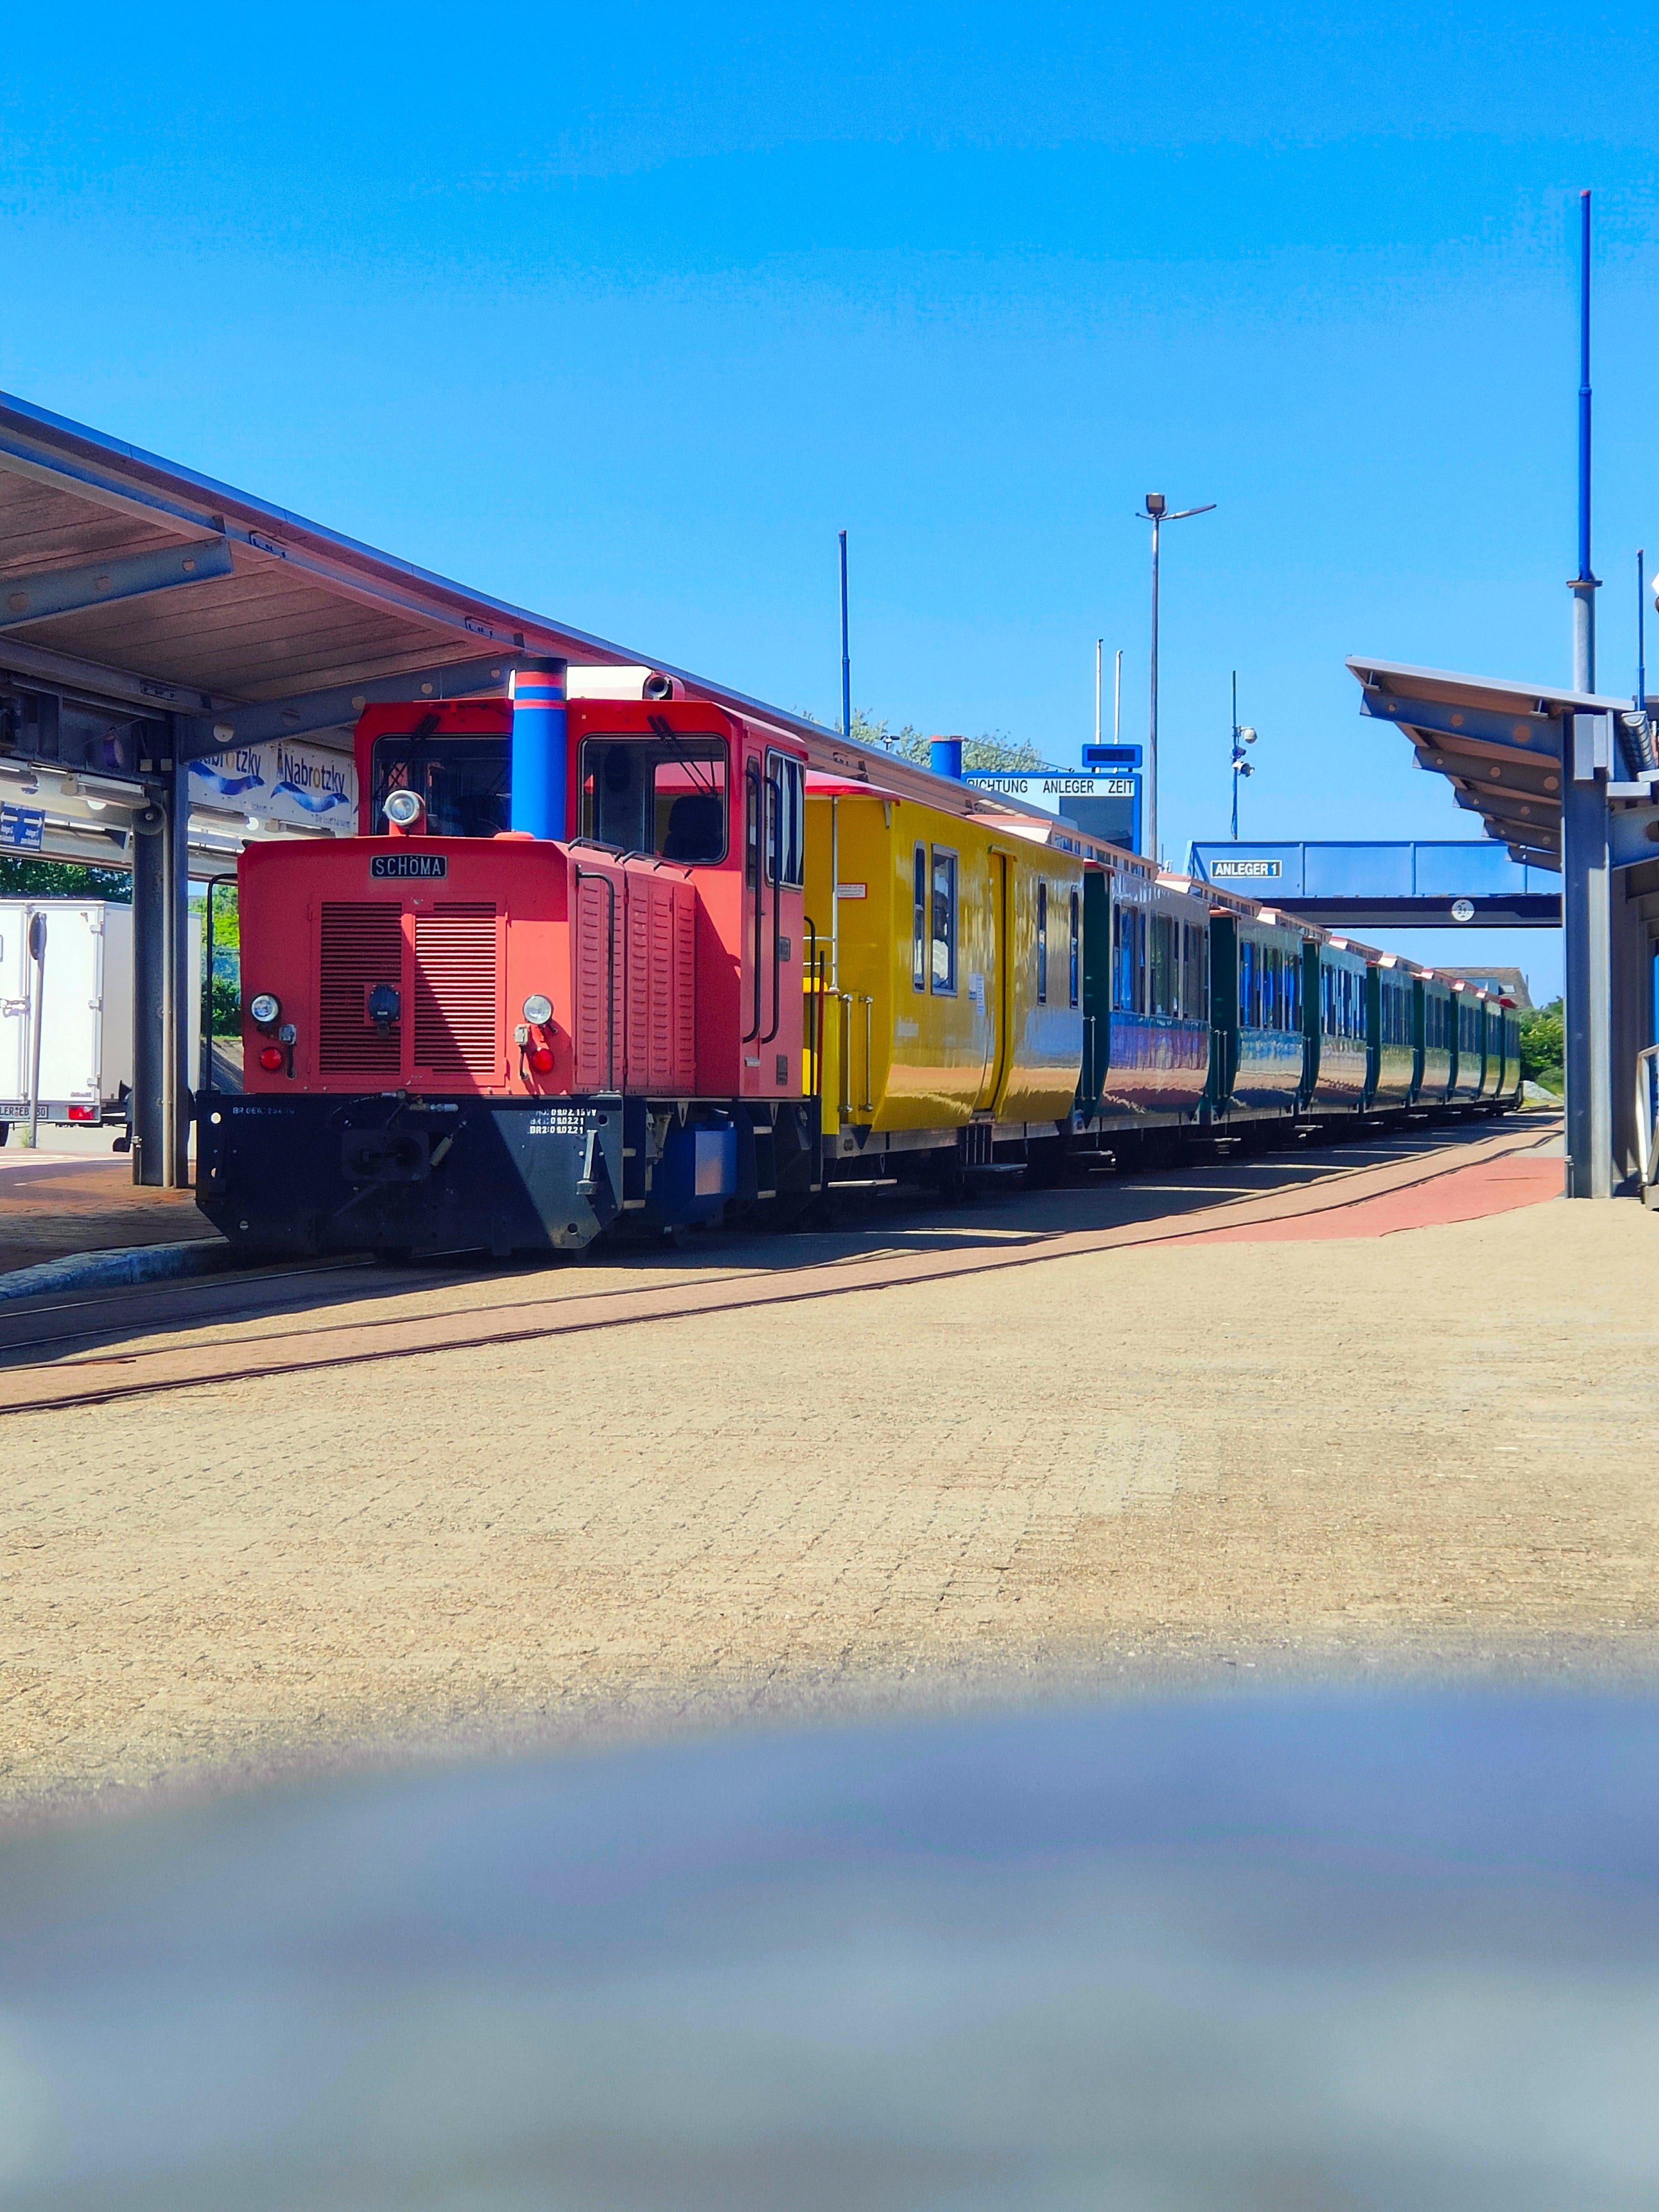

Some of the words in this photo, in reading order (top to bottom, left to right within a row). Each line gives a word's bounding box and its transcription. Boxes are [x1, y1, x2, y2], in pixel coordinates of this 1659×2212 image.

[284, 754, 345, 794] Nabrotzky
[1043, 780, 1094, 794] ANLEGER
[1108, 780, 1134, 794] ZEIT
[375, 856, 441, 875] SCHÖMA
[1215, 863, 1269, 875] ANLEGER
[1271, 863, 1277, 875] 1
